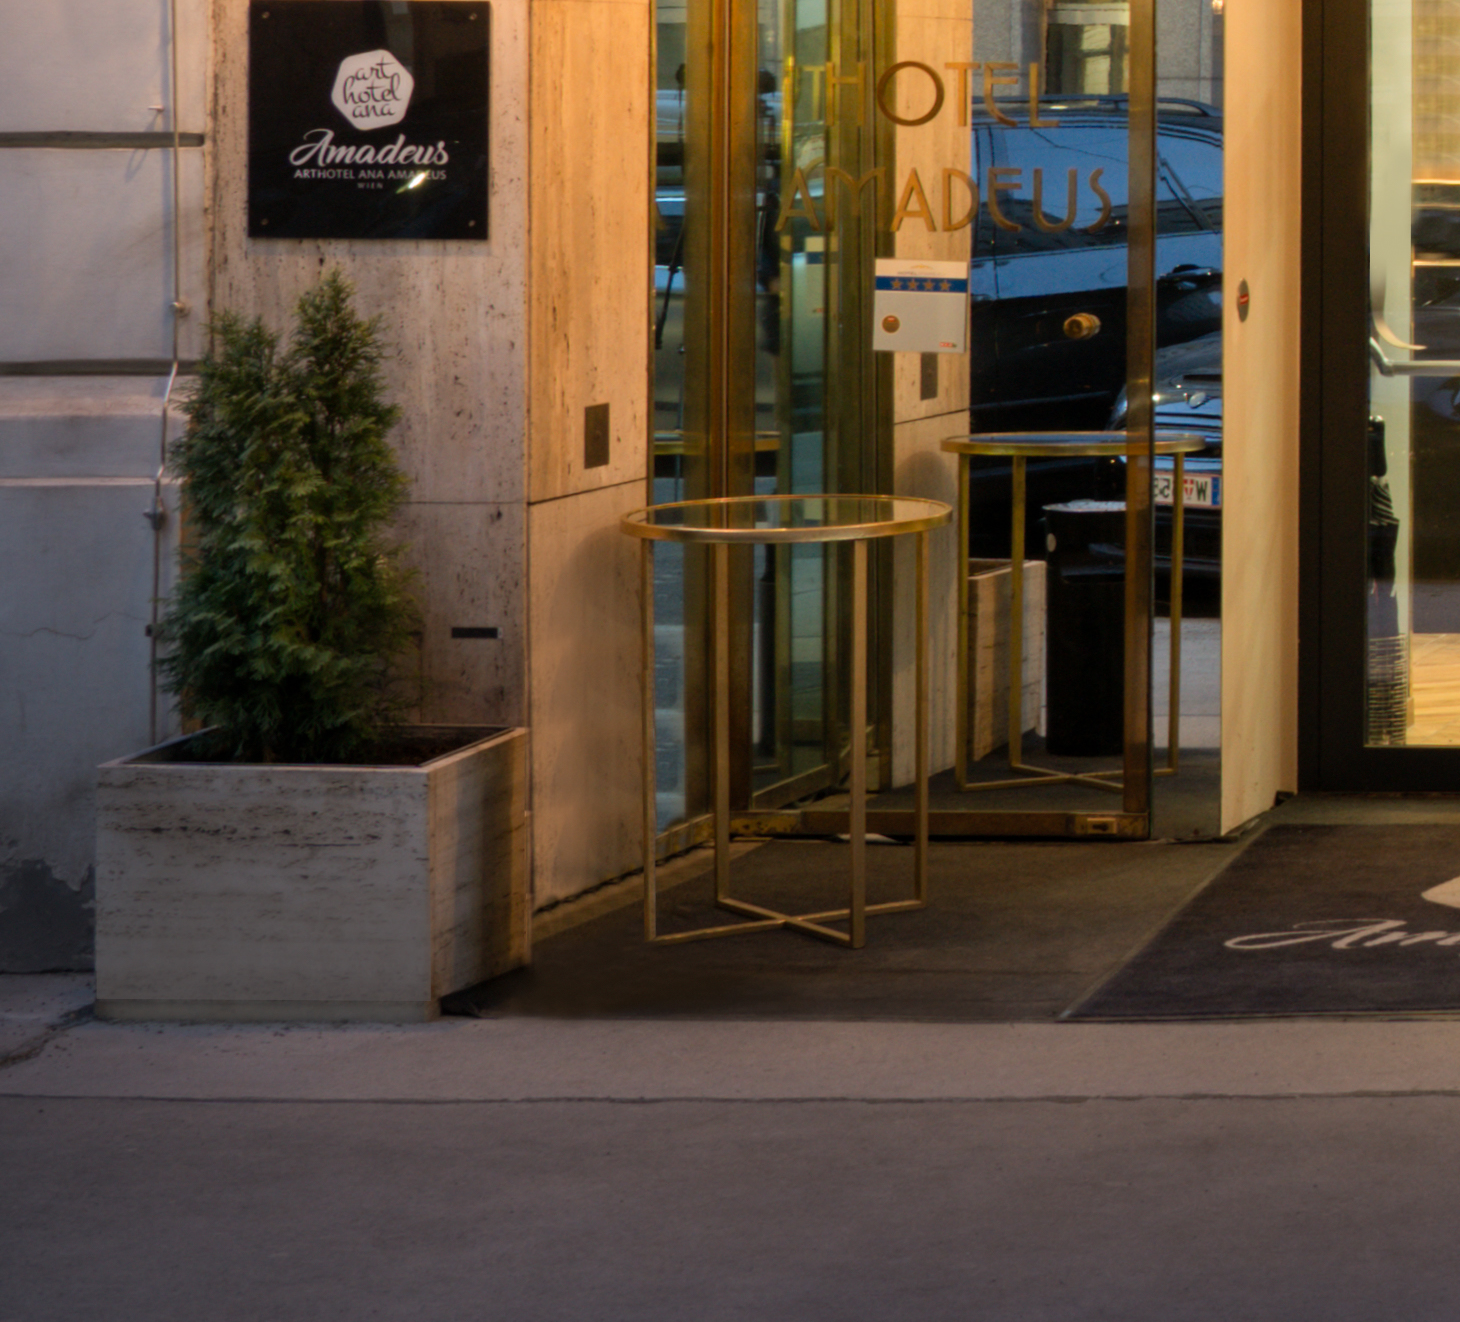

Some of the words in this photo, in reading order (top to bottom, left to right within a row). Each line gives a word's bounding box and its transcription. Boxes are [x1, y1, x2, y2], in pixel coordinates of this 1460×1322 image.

[354, 56, 396, 81] art
[343, 73, 401, 105] hotel
[825, 60, 1060, 128] HOTEL
[352, 103, 395, 118] ana
[288, 128, 449, 167] Amadeus
[293, 169, 354, 179] ARTHOTEL
[358, 169, 385, 179] ANA
[774, 166, 1114, 233] AMADEUS
